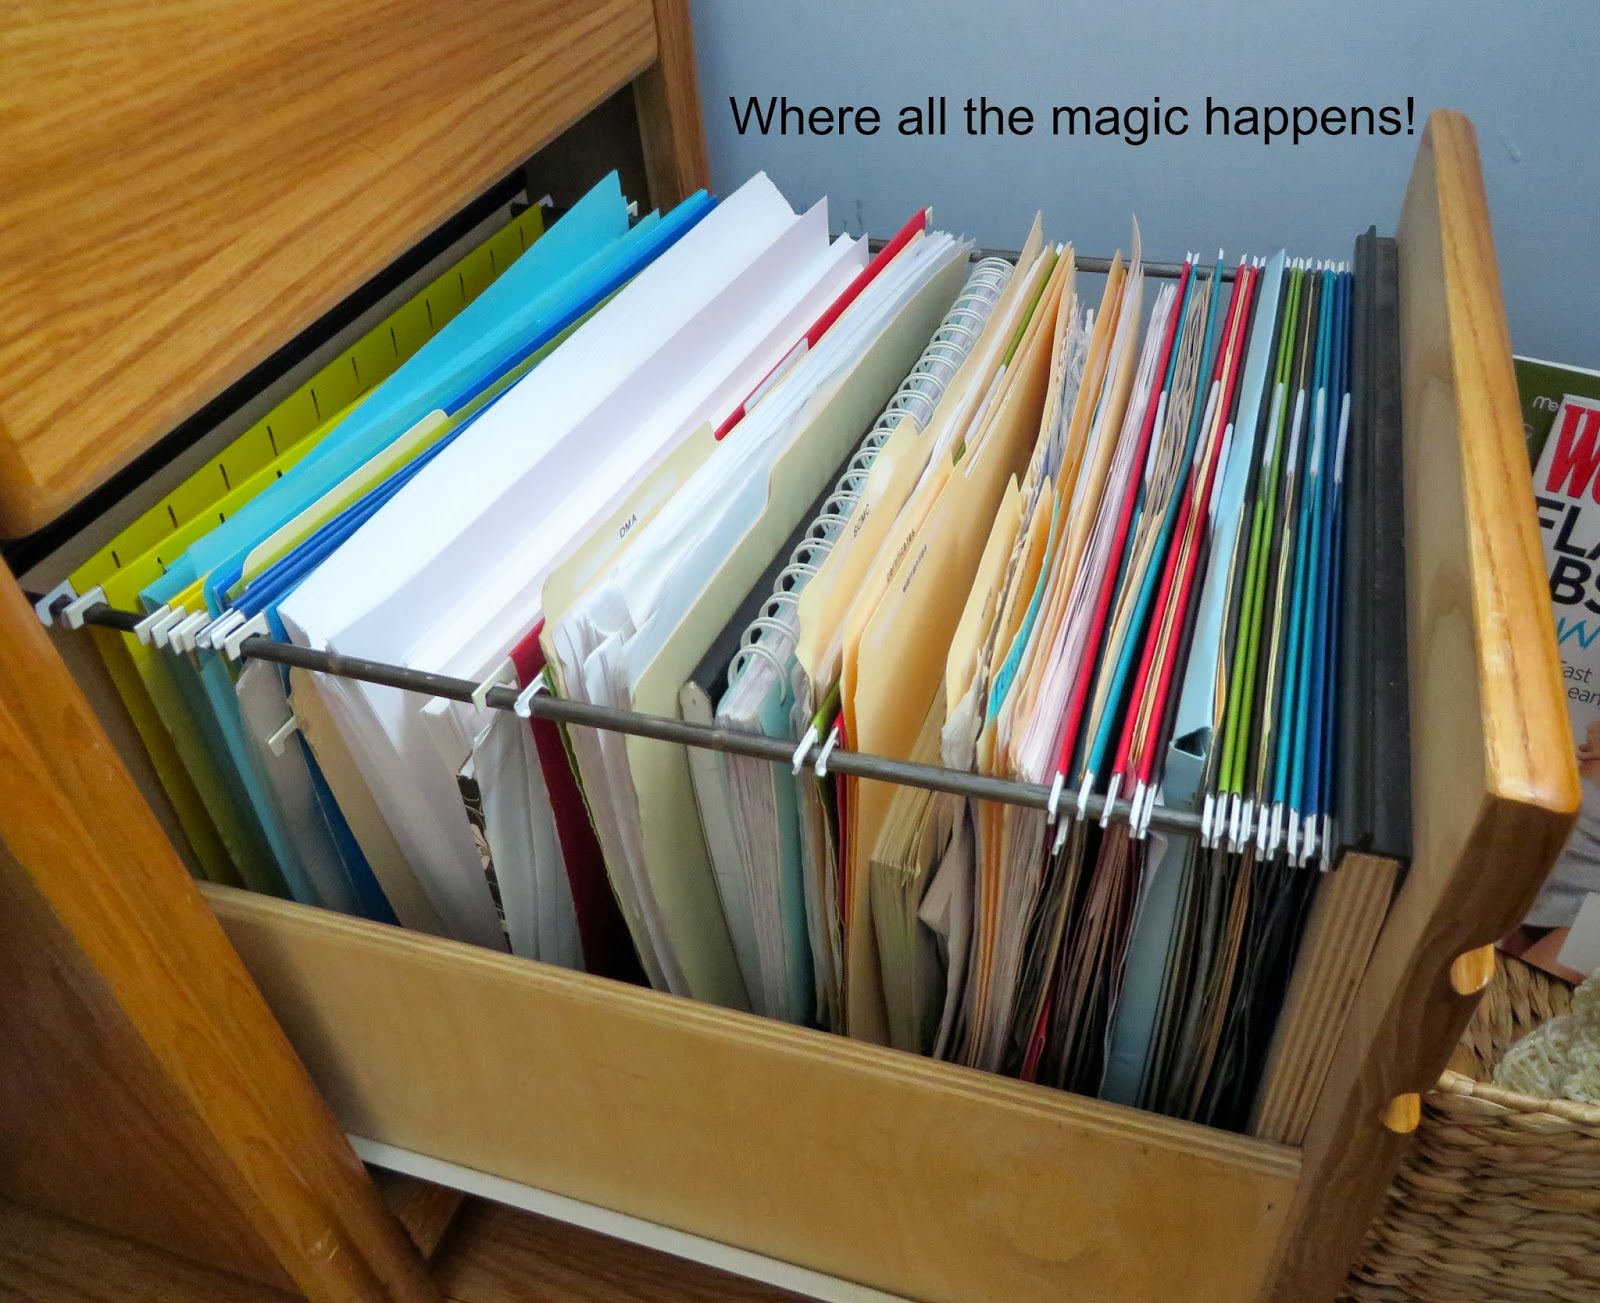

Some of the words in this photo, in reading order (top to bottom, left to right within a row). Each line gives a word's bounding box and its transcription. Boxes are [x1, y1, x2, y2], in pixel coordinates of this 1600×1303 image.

[1545, 403, 1600, 506] W
[619, 513, 638, 539] DMA
[1561, 660, 1593, 684] ast
[1565, 686, 1600, 707] ean
